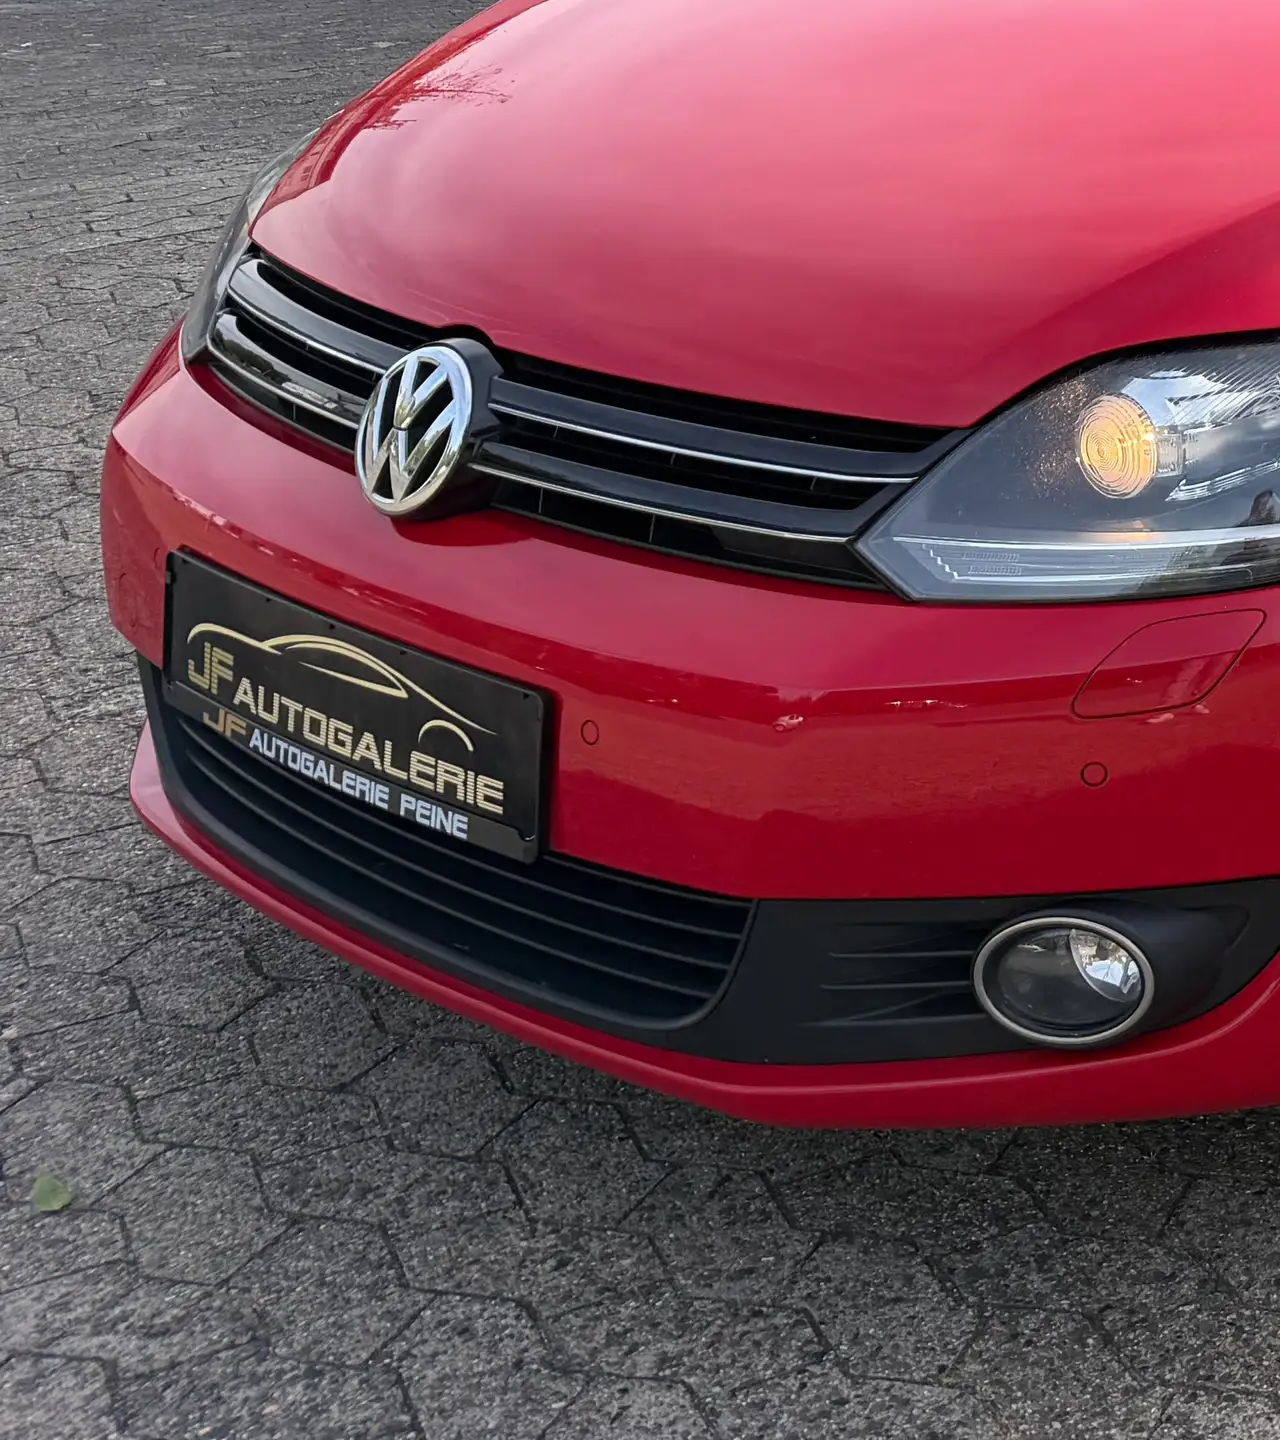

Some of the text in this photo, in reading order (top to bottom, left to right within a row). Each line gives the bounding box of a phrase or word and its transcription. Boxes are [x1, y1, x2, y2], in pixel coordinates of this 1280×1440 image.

[187, 641, 505, 815] JF AUTOGALERIE
[202, 709, 470, 841] JF AUTOGALERIE PEINE
